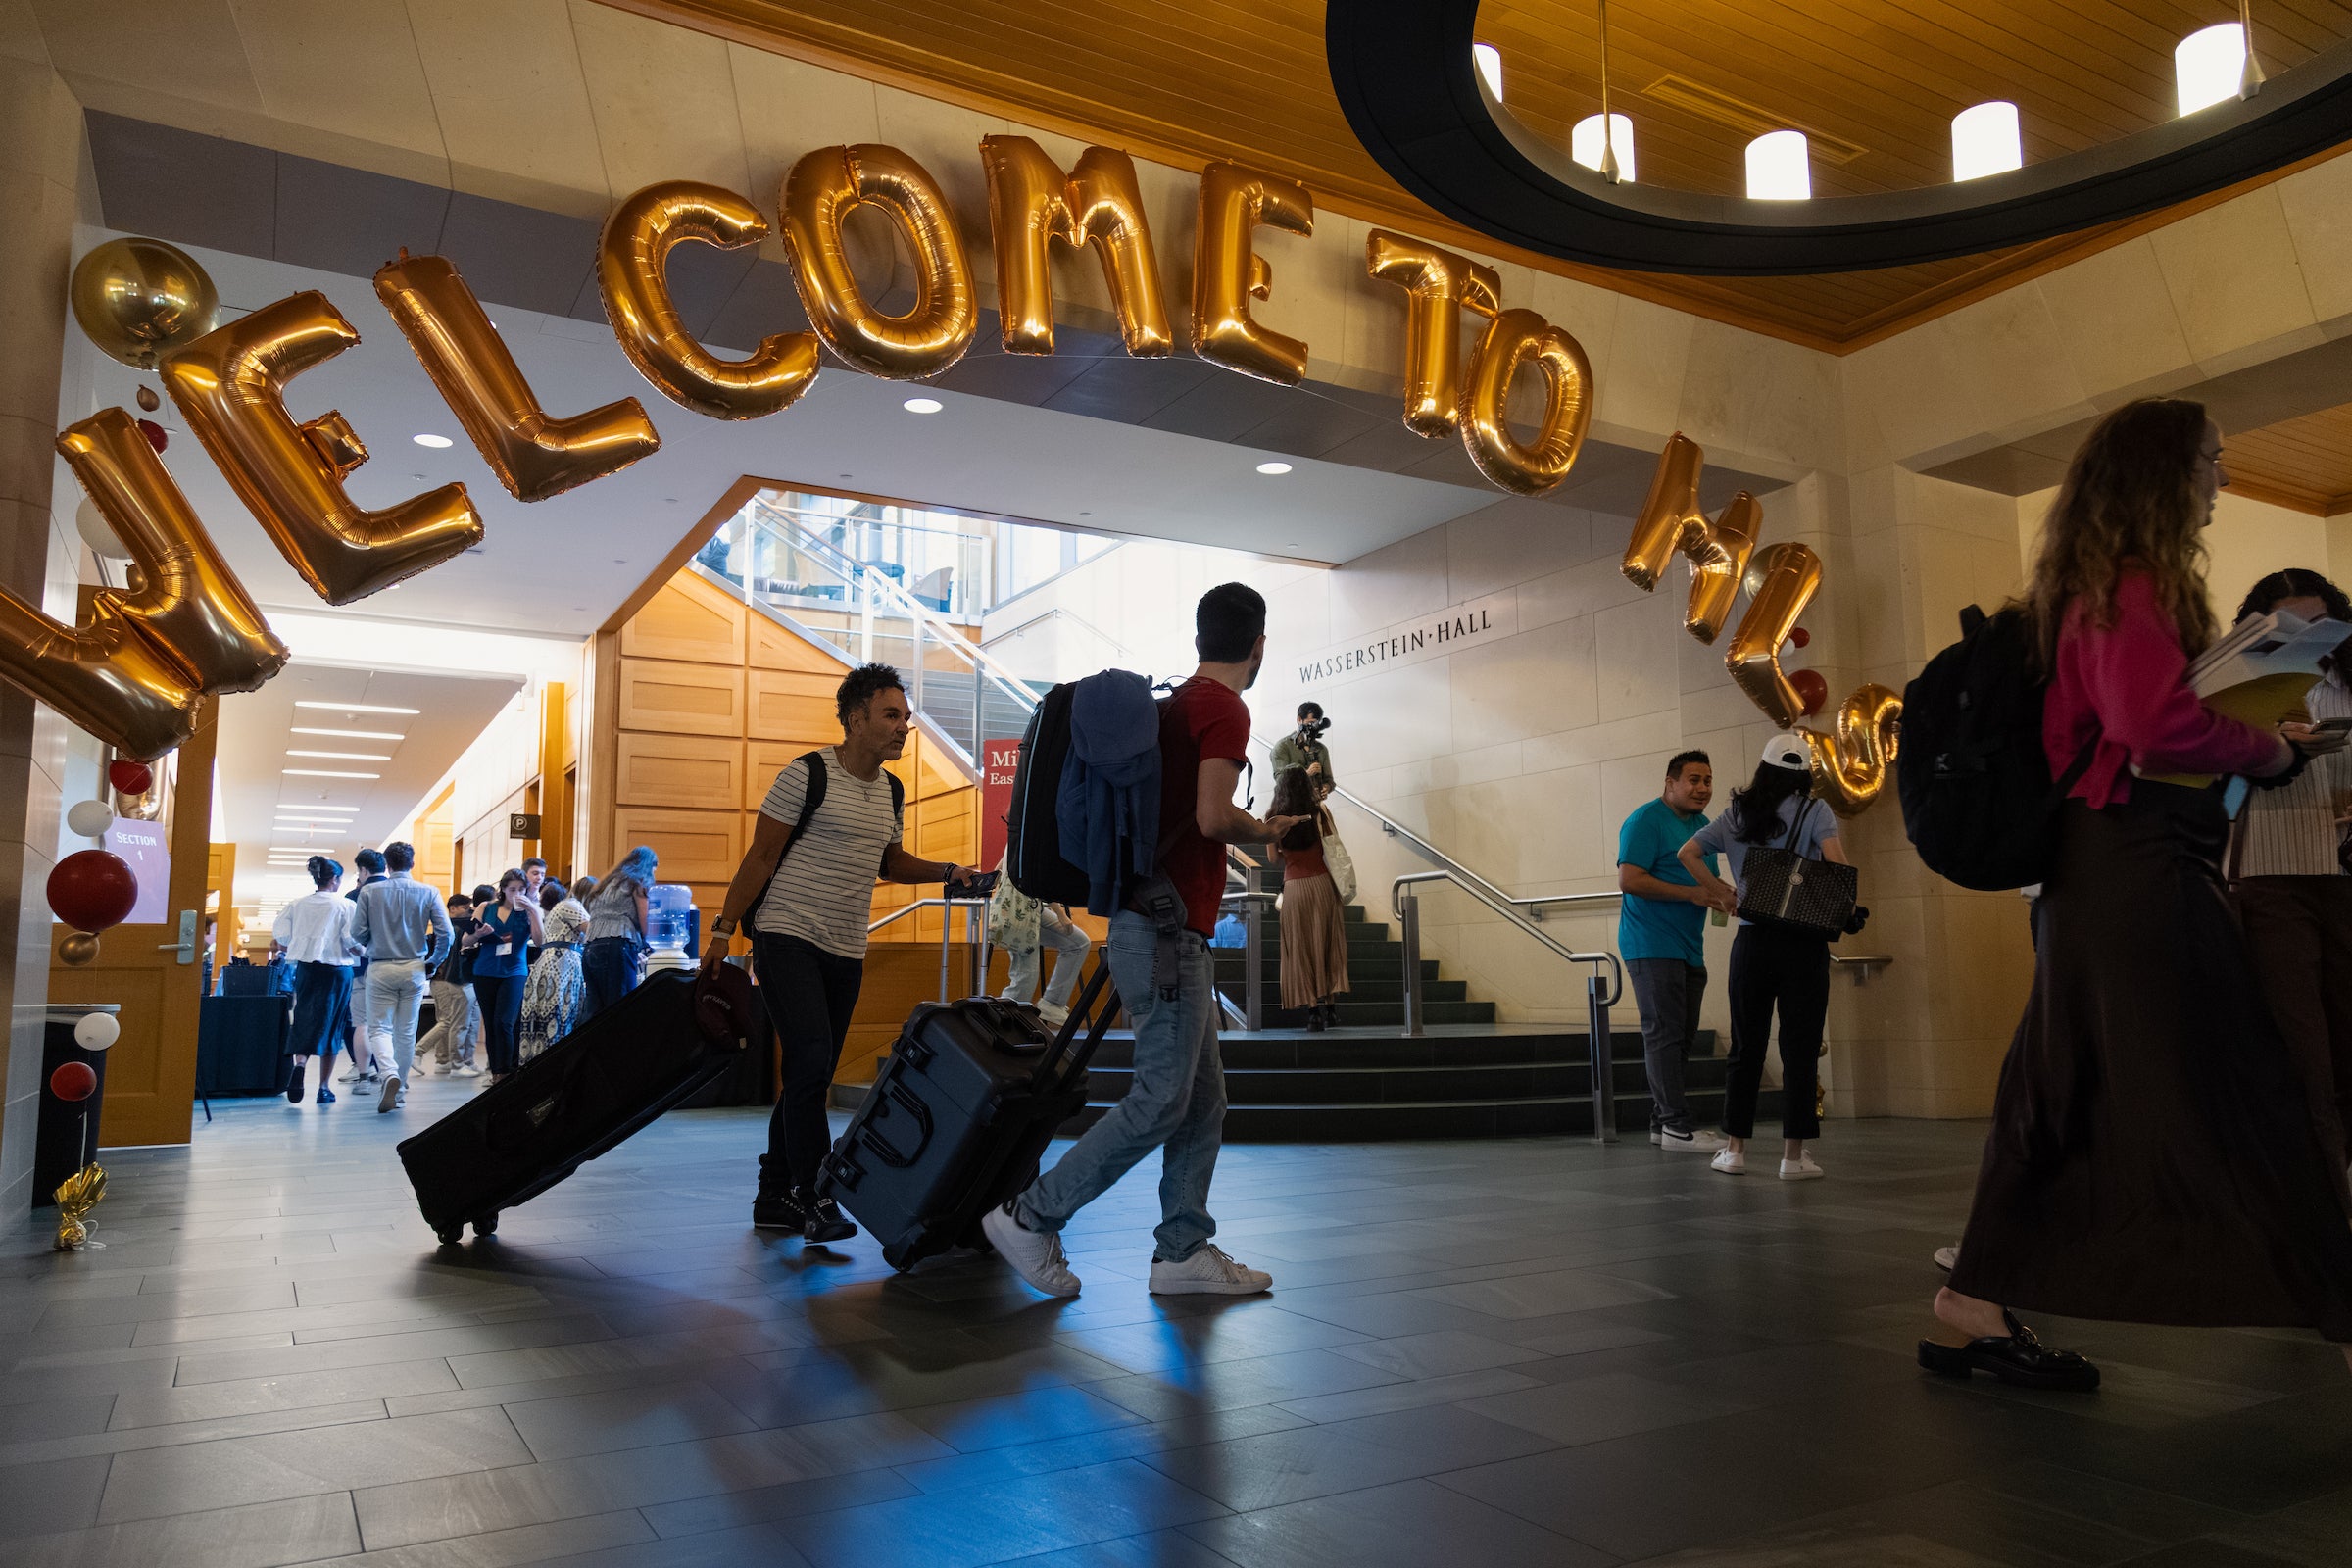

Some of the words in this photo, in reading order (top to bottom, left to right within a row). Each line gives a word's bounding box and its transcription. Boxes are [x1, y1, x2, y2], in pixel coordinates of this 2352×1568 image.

[0, 134, 1314, 762] WELCOME
[1366, 227, 1593, 496] TO
[1620, 430, 1904, 820] HLS
[990, 773, 1015, 785] Eas
[116, 832, 157, 847] SECTION
[137, 850, 144, 861] 1
